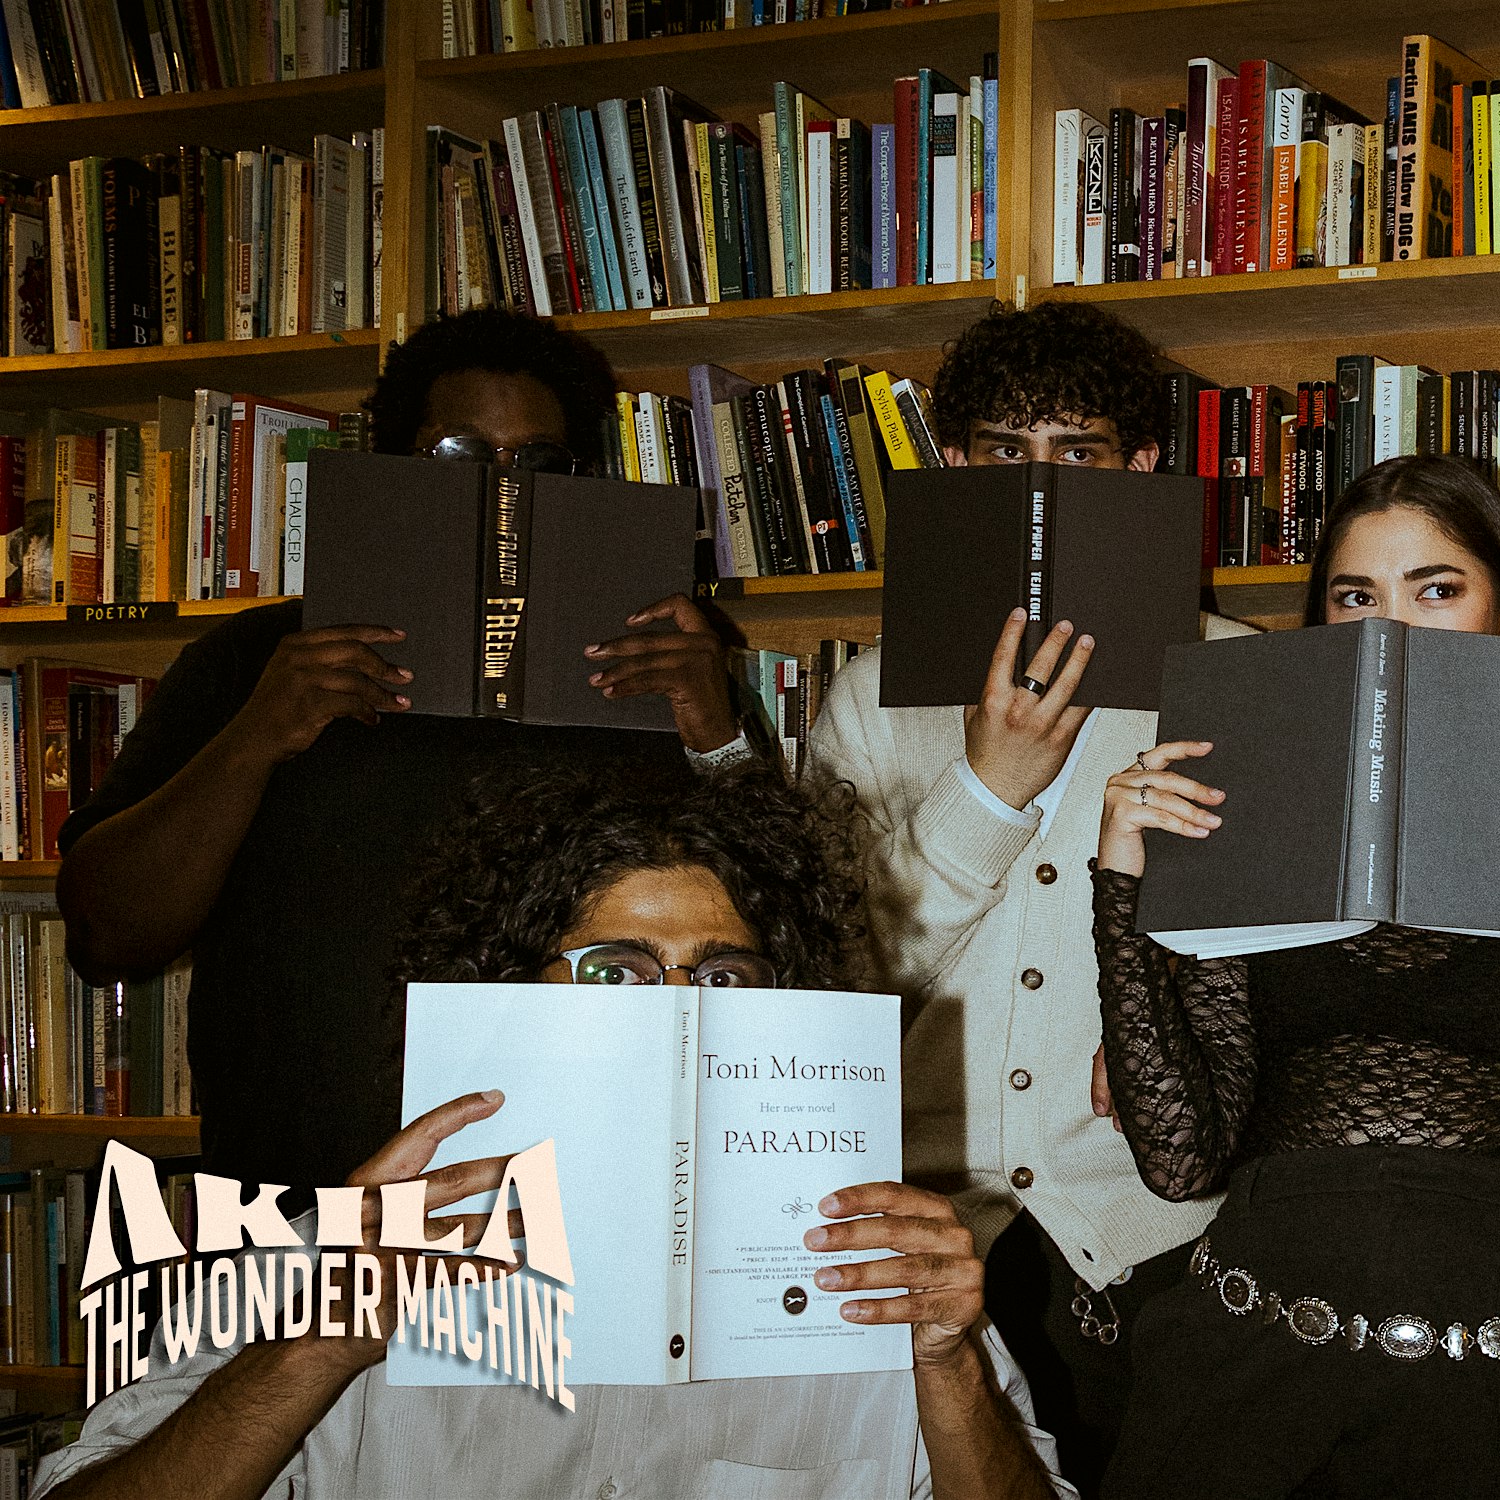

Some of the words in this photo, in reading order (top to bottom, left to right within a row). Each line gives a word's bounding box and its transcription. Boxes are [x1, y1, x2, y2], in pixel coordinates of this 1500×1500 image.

[1404, 42, 1419, 98] Martin
[1222, 94, 1233, 127] ISABEL
[1280, 91, 1295, 141] Zorro
[1402, 101, 1418, 147] AMIS
[1387, 117, 1395, 143] Train
[1149, 137, 1157, 166] DEATH
[1220, 129, 1231, 190] ALLENDE
[1237, 118, 1248, 181] ISABEL
[617, 175, 625, 194] The
[839, 156, 848, 212] MARIANNE
[1149, 168, 1156, 179] OF
[1191, 141, 1204, 206] Aphrodite
[1279, 151, 1290, 199] ISABEL
[1387, 171, 1395, 205] MARTIN
[1401, 152, 1415, 208] Yellow
[104, 169, 119, 233] POEMS
[621, 196, 629, 218] Ends
[1148, 189, 1156, 214] HERO
[624, 219, 630, 230] of
[839, 216, 849, 252] MOORE
[1234, 187, 1246, 267] ALLENDE
[1276, 202, 1289, 265] ALLENDE
[1385, 207, 1394, 237] AMIS
[1399, 212, 1413, 248] DOG
[108, 237, 116, 291] ELIZABETH
[164, 230, 176, 323] BLAKE
[629, 250, 641, 277] Earth
[840, 256, 849, 292] READE
[109, 294, 117, 330] BISHOP
[1313, 390, 1324, 429] SURVIVAL
[1383, 379, 1392, 408] JANE
[755, 390, 774, 464] Cornucopia
[834, 408, 851, 452] HISTORY
[875, 387, 891, 420] Sylvia
[886, 424, 901, 452] Plath
[844, 454, 854, 470] OF
[1299, 448, 1307, 491] ATWOOD
[1315, 449, 1323, 492] ATWOOD
[849, 476, 860, 492] MY
[287, 477, 302, 563] CHAUCER
[851, 495, 867, 529] HEART
[1032, 491, 1044, 524] BLACK
[499, 532, 518, 587] FRANZEN
[1031, 525, 1043, 561] PAPER
[1030, 571, 1042, 595] TEJU
[85, 606, 149, 621] POETRY
[1029, 597, 1041, 621] COLE
[483, 598, 525, 679] FREEDOM
[1369, 688, 1388, 750] Making
[1370, 754, 1385, 803] Music
[702, 1054, 759, 1080] Toni
[770, 1056, 886, 1082] Morrison
[760, 1103, 779, 1113] Her
[783, 1105, 804, 1113] new
[808, 1103, 835, 1113] novel
[723, 1131, 868, 1154] PARADISE
[672, 1140, 689, 1267] PARADISE
